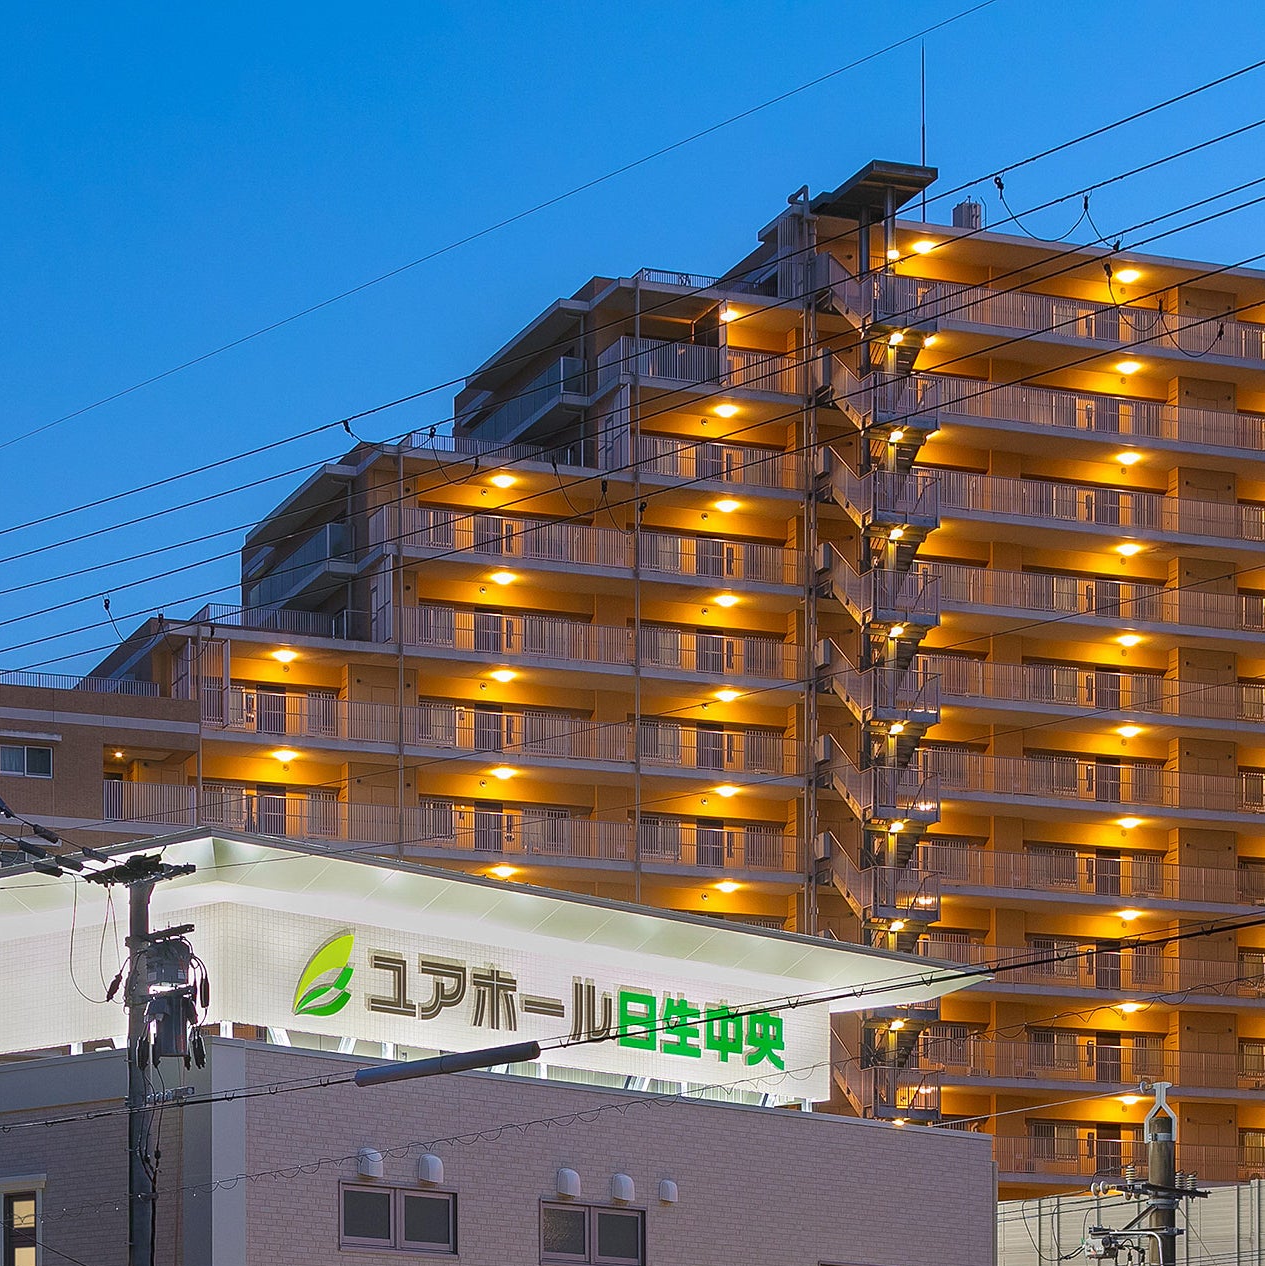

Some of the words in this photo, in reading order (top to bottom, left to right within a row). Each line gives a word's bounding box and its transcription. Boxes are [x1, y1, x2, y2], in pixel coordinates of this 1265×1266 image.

[368, 955, 785, 1070] ユアホール日生中央
